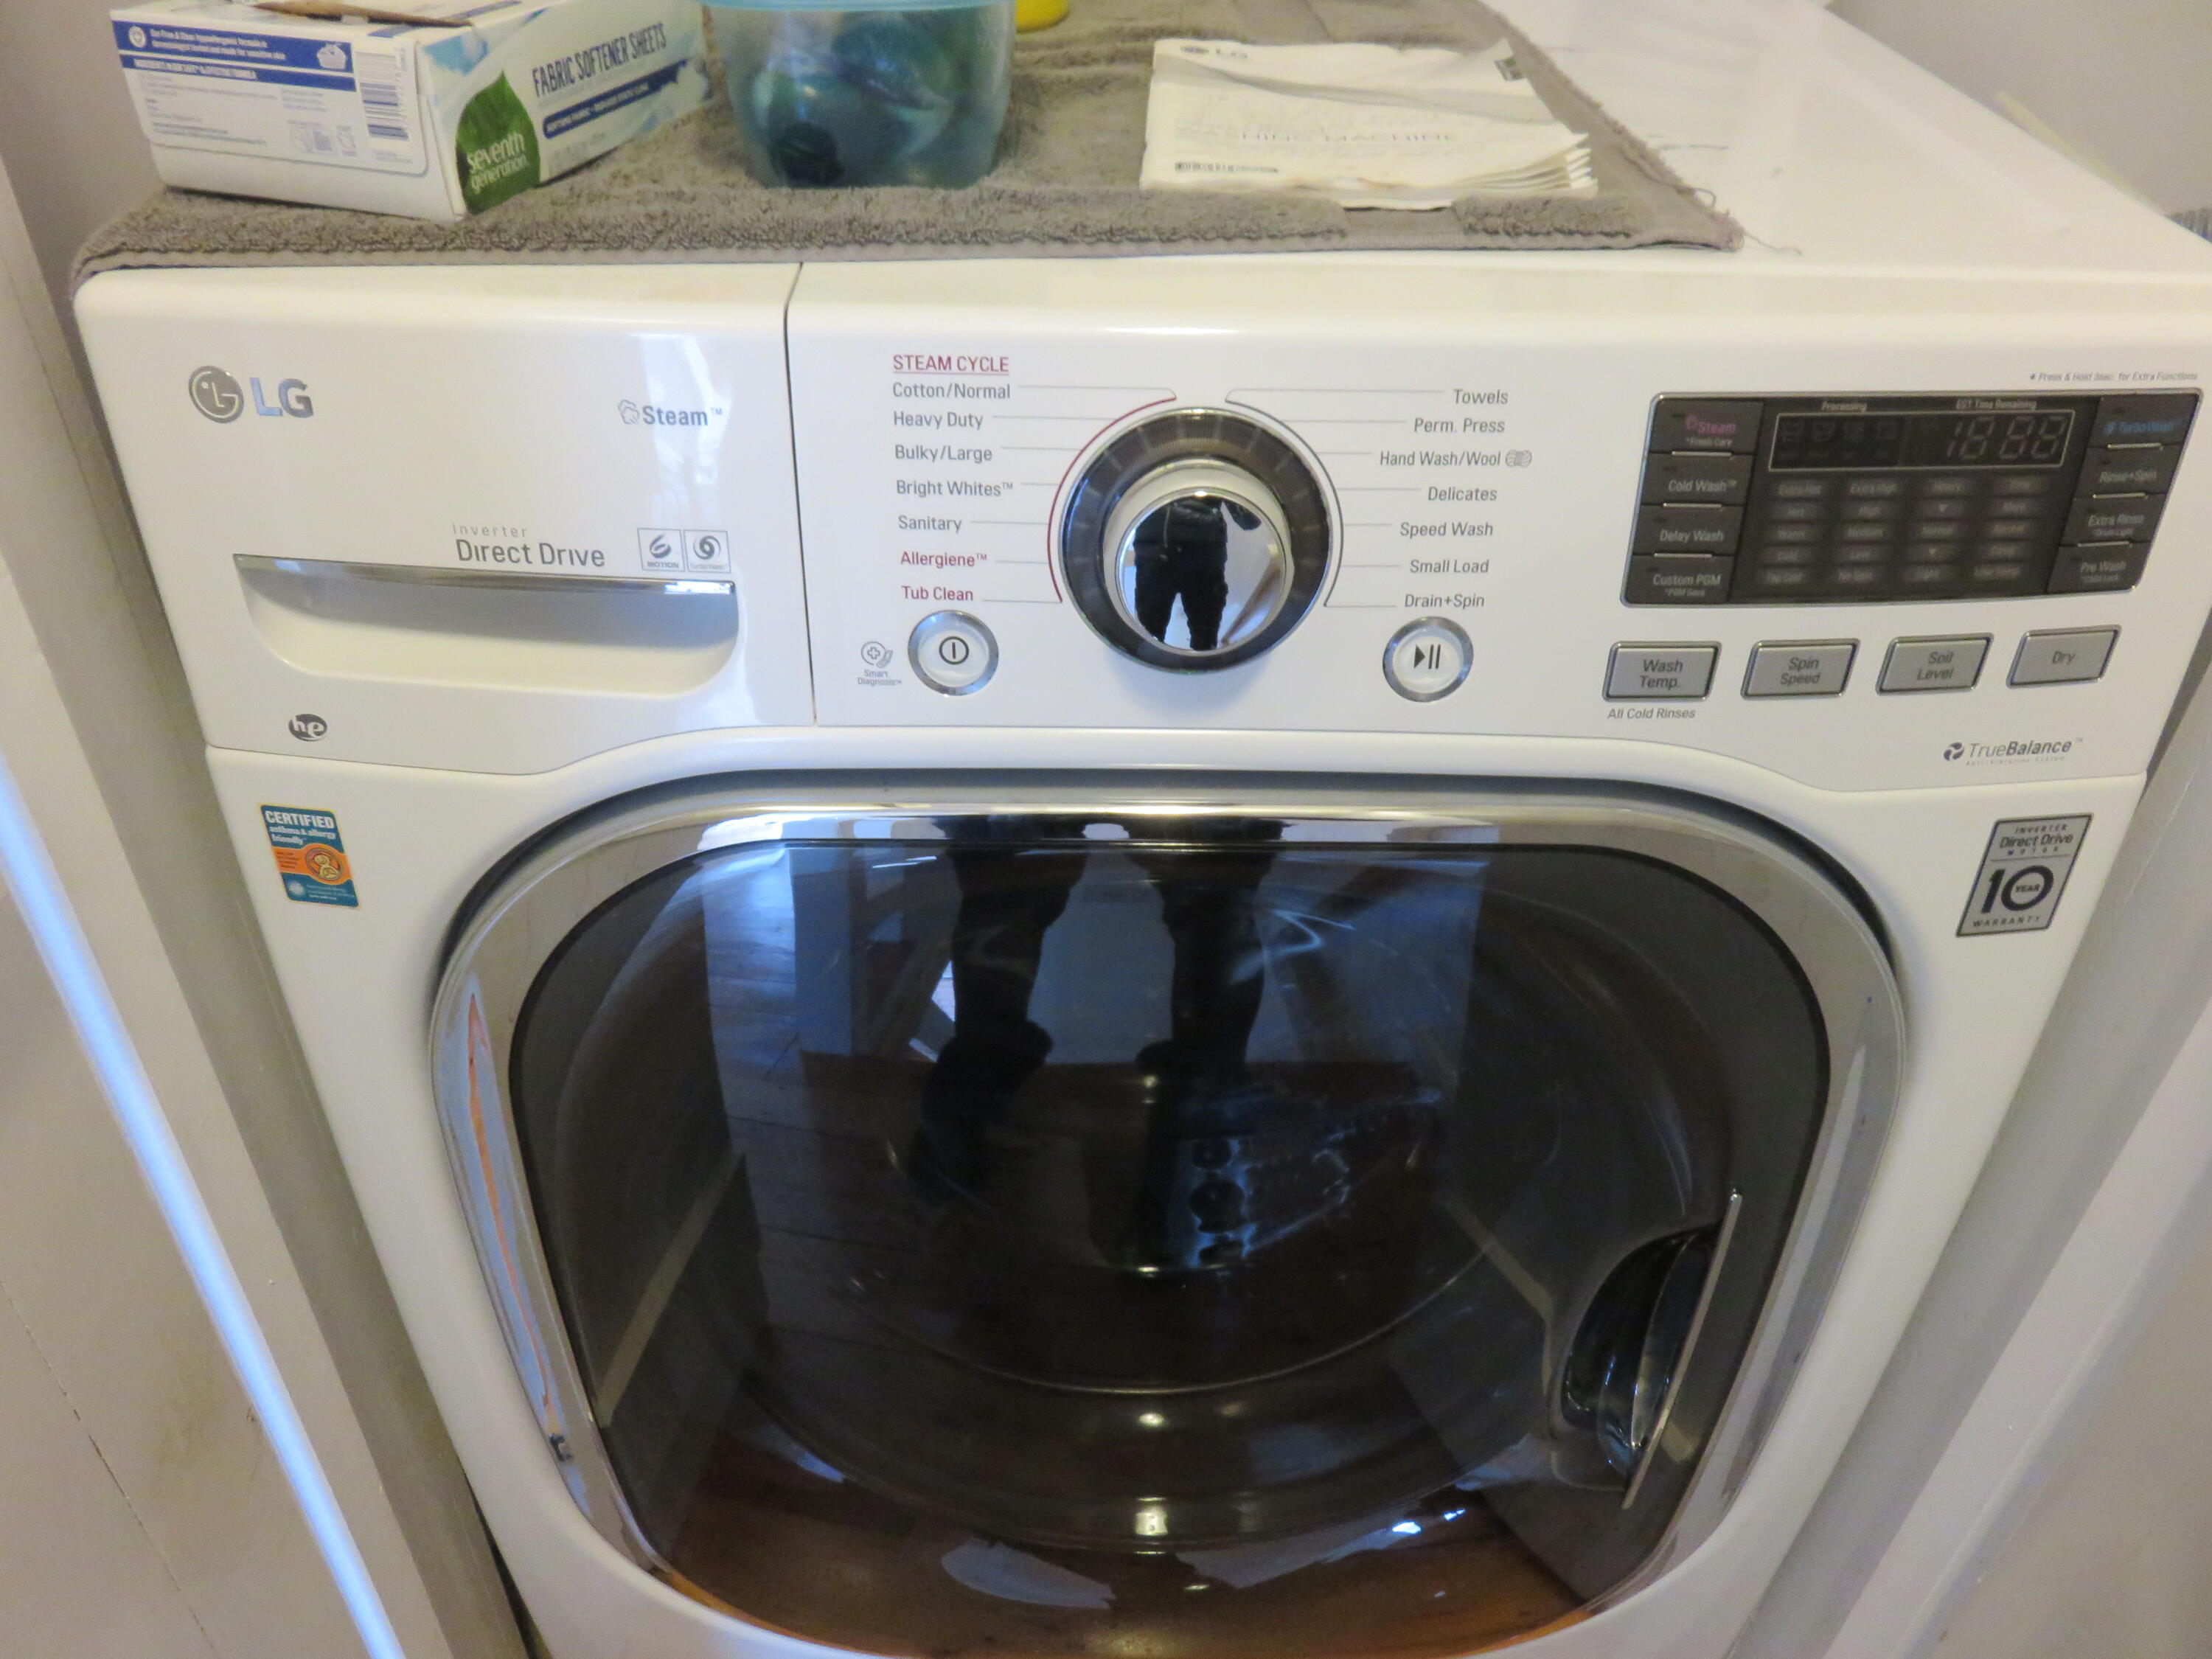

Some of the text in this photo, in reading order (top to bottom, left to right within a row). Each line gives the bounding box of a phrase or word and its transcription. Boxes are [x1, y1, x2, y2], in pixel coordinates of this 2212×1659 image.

[531, 58, 575, 97] FABRIC
[574, 38, 629, 83] SOFTENER
[628, 22, 667, 59] SHEETS
[467, 131, 526, 173] seventh
[470, 154, 532, 195] generation
[893, 355, 1009, 372] STEAM CYCLE
[248, 377, 314, 418] LG
[893, 381, 1011, 399] Cotton/Normal
[1453, 389, 1509, 405] Towels
[894, 411, 984, 431] Heavy Duty
[1413, 417, 1506, 434] Perm. Press
[1697, 420, 1736, 434] Steam
[894, 444, 993, 464] Bulky/Large
[1380, 451, 1501, 466] Hand Wash/Wool
[896, 479, 944, 498] Bright
[1427, 486, 1498, 501] Delicates
[1668, 479, 1694, 493] Cold
[452, 523, 527, 538] Inverter
[897, 515, 962, 534] Sanitary
[1399, 521, 1494, 540] Speed Wash
[1659, 529, 1725, 544] Delay Wash
[456, 538, 605, 568] Direct Drive
[1409, 559, 1490, 574] Small Load
[1652, 574, 1722, 586] Custom PGM
[900, 585, 973, 601] Tub Clean
[1404, 593, 1485, 610] Drain+Spin
[1787, 655, 1820, 672] Spin
[1927, 650, 1954, 665] Soil
[2051, 650, 2076, 665] Dry
[863, 669, 888, 678] Smart
[1641, 658, 1684, 674] Wash
[1779, 671, 1821, 688] Speed
[1916, 668, 1954, 682] Level
[1607, 706, 1697, 720] All Cold Rinses
[265, 810, 335, 830] CERTIFIED
[2014, 823, 2067, 835] INVERTER
[1999, 833, 2074, 849] Direct Drive
[2007, 846, 2059, 856] MOTOR
[1980, 865, 2054, 914] 10
[2014, 883, 2041, 893] YEAR
[1972, 916, 2042, 928] WARRANTY
